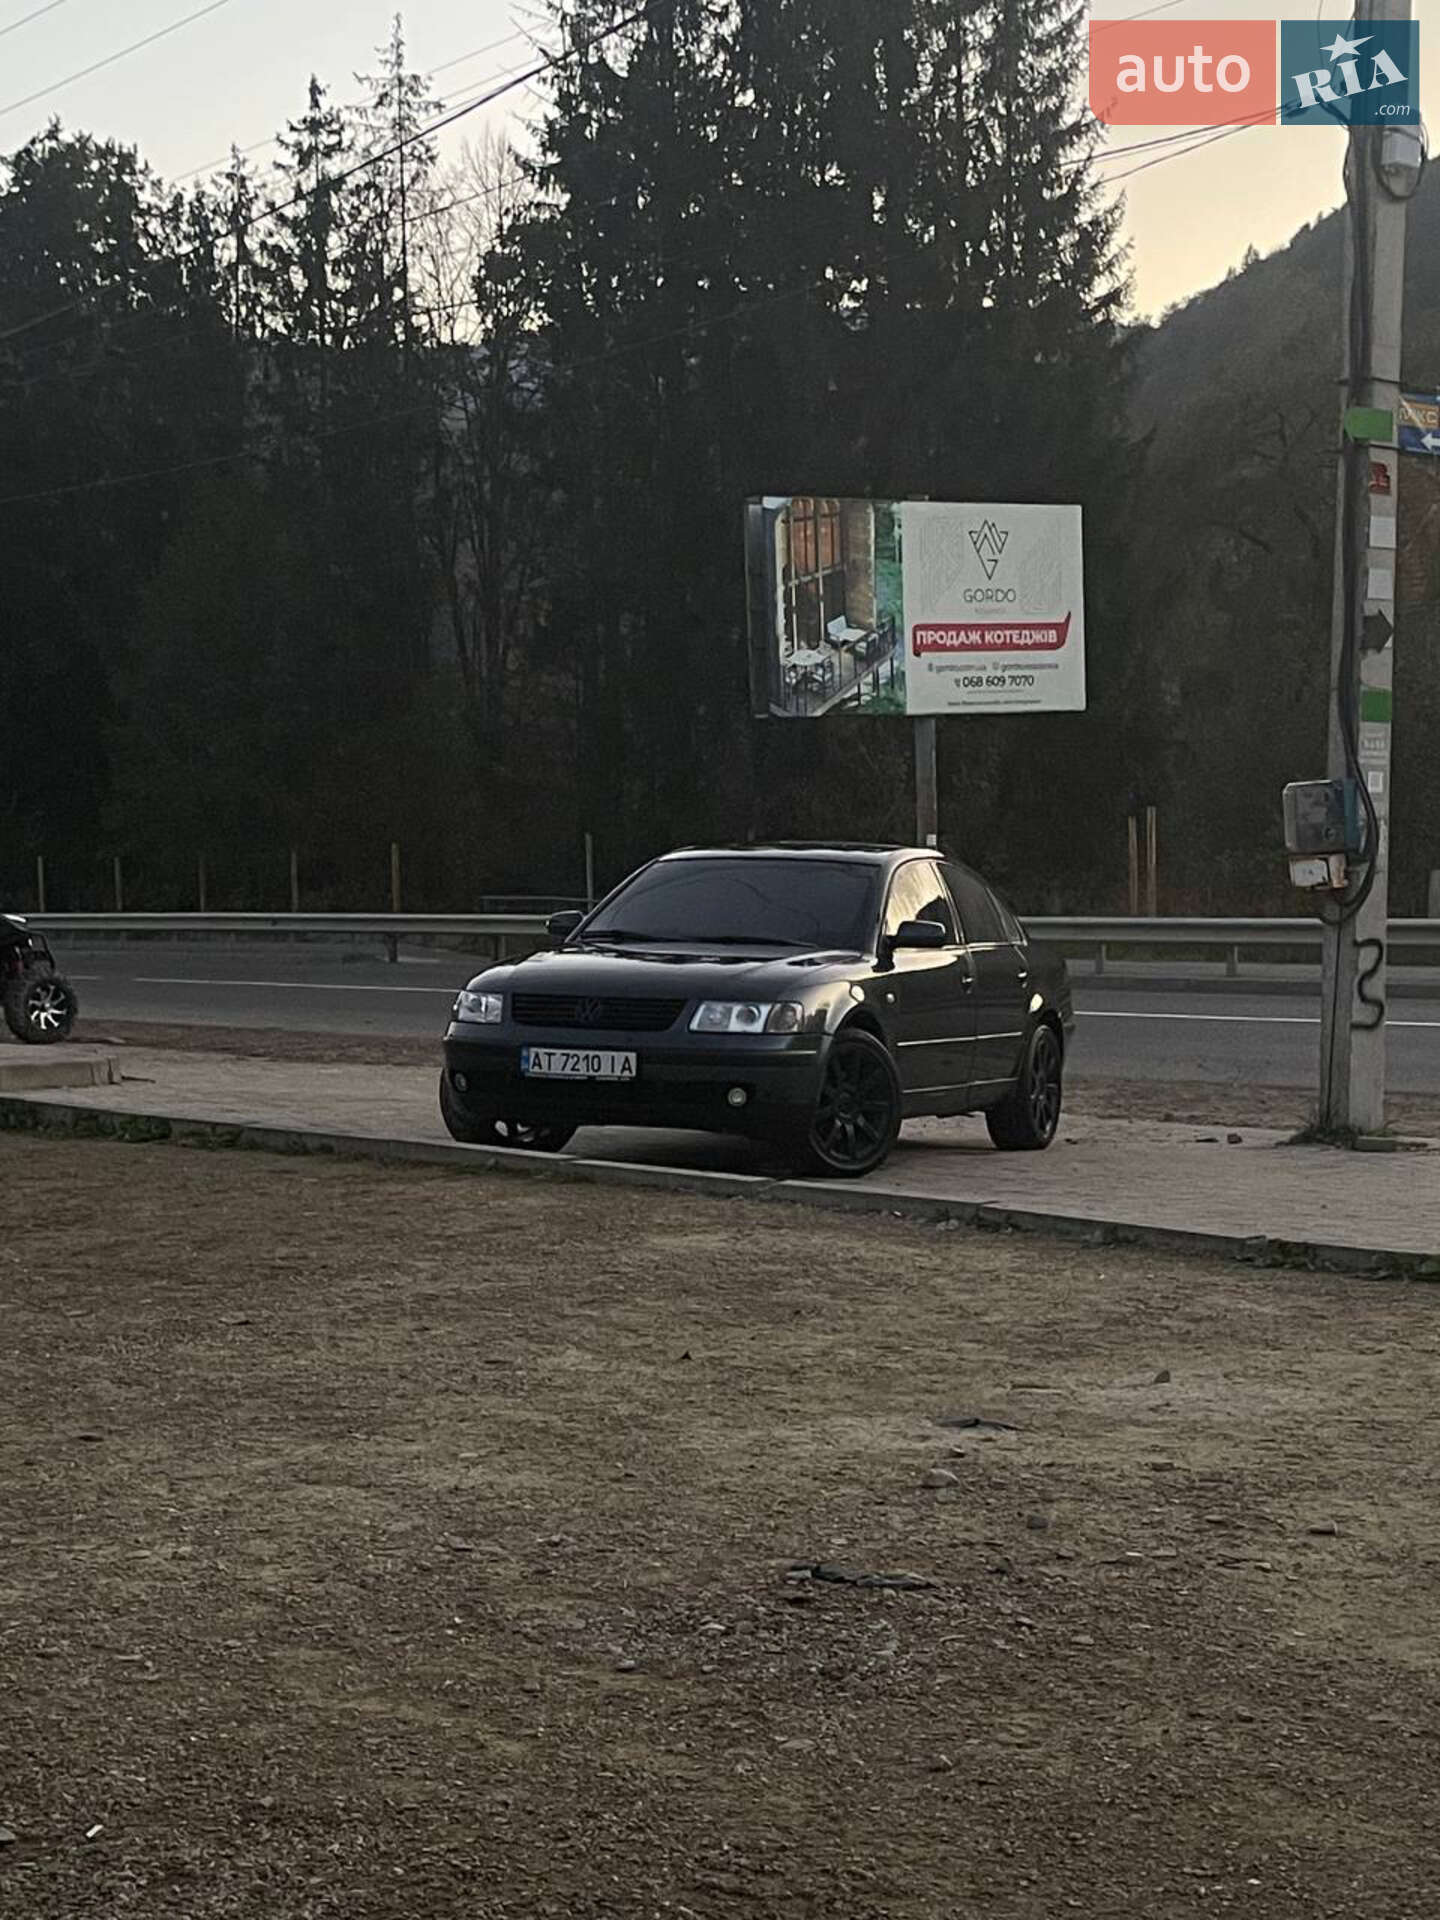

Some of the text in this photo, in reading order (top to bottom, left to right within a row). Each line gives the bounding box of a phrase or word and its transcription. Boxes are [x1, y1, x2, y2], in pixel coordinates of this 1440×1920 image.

[963, 588, 1016, 603] GORDO
[916, 629, 1057, 646] ПРОДАЖ КОТЕДЖІВ
[962, 675, 1034, 688] 068 609 7070
[531, 1052, 556, 1071] AT
[560, 1053, 601, 1073] 7210
